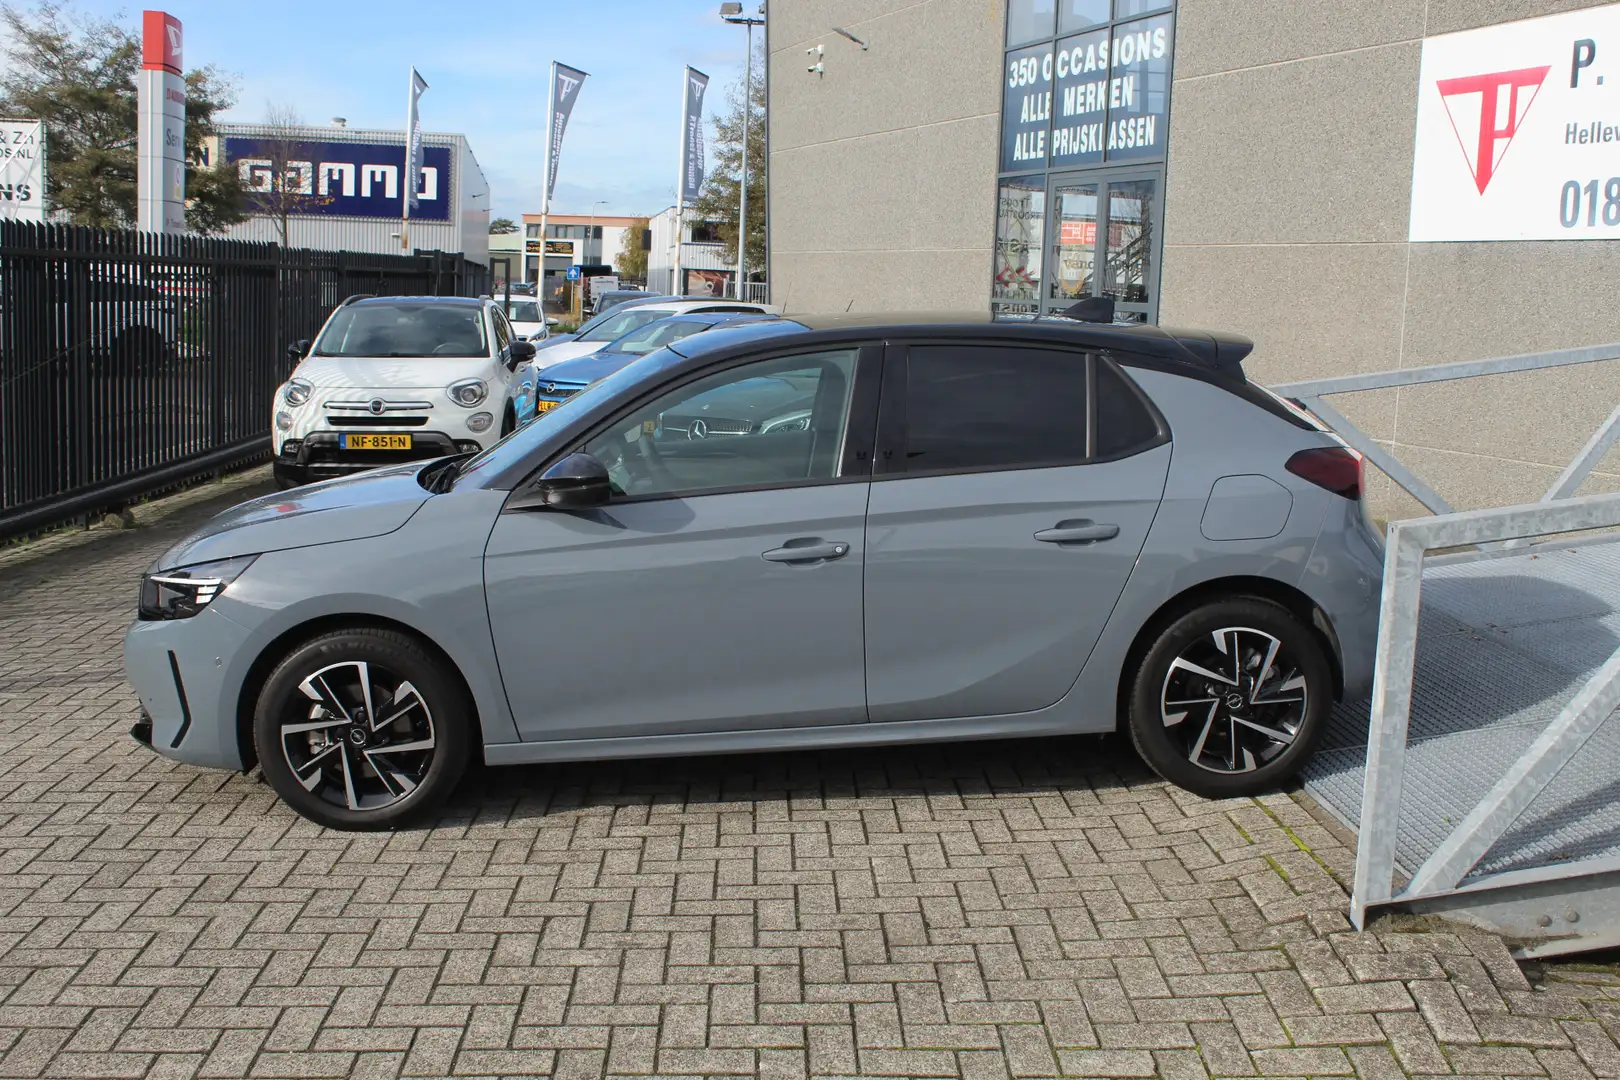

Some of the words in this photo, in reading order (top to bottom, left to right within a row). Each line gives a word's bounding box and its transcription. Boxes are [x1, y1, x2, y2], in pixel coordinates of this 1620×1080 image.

[1009, 57, 1037, 88] 350
[1042, 28, 1166, 81] OCCASIONS
[1020, 92, 1050, 123] ALLE
[1063, 76, 1134, 116] MERKEN
[1013, 130, 1045, 161] ALLE
[1559, 176, 1620, 228] 018
[351, 436, 406, 448] NF-851-N
